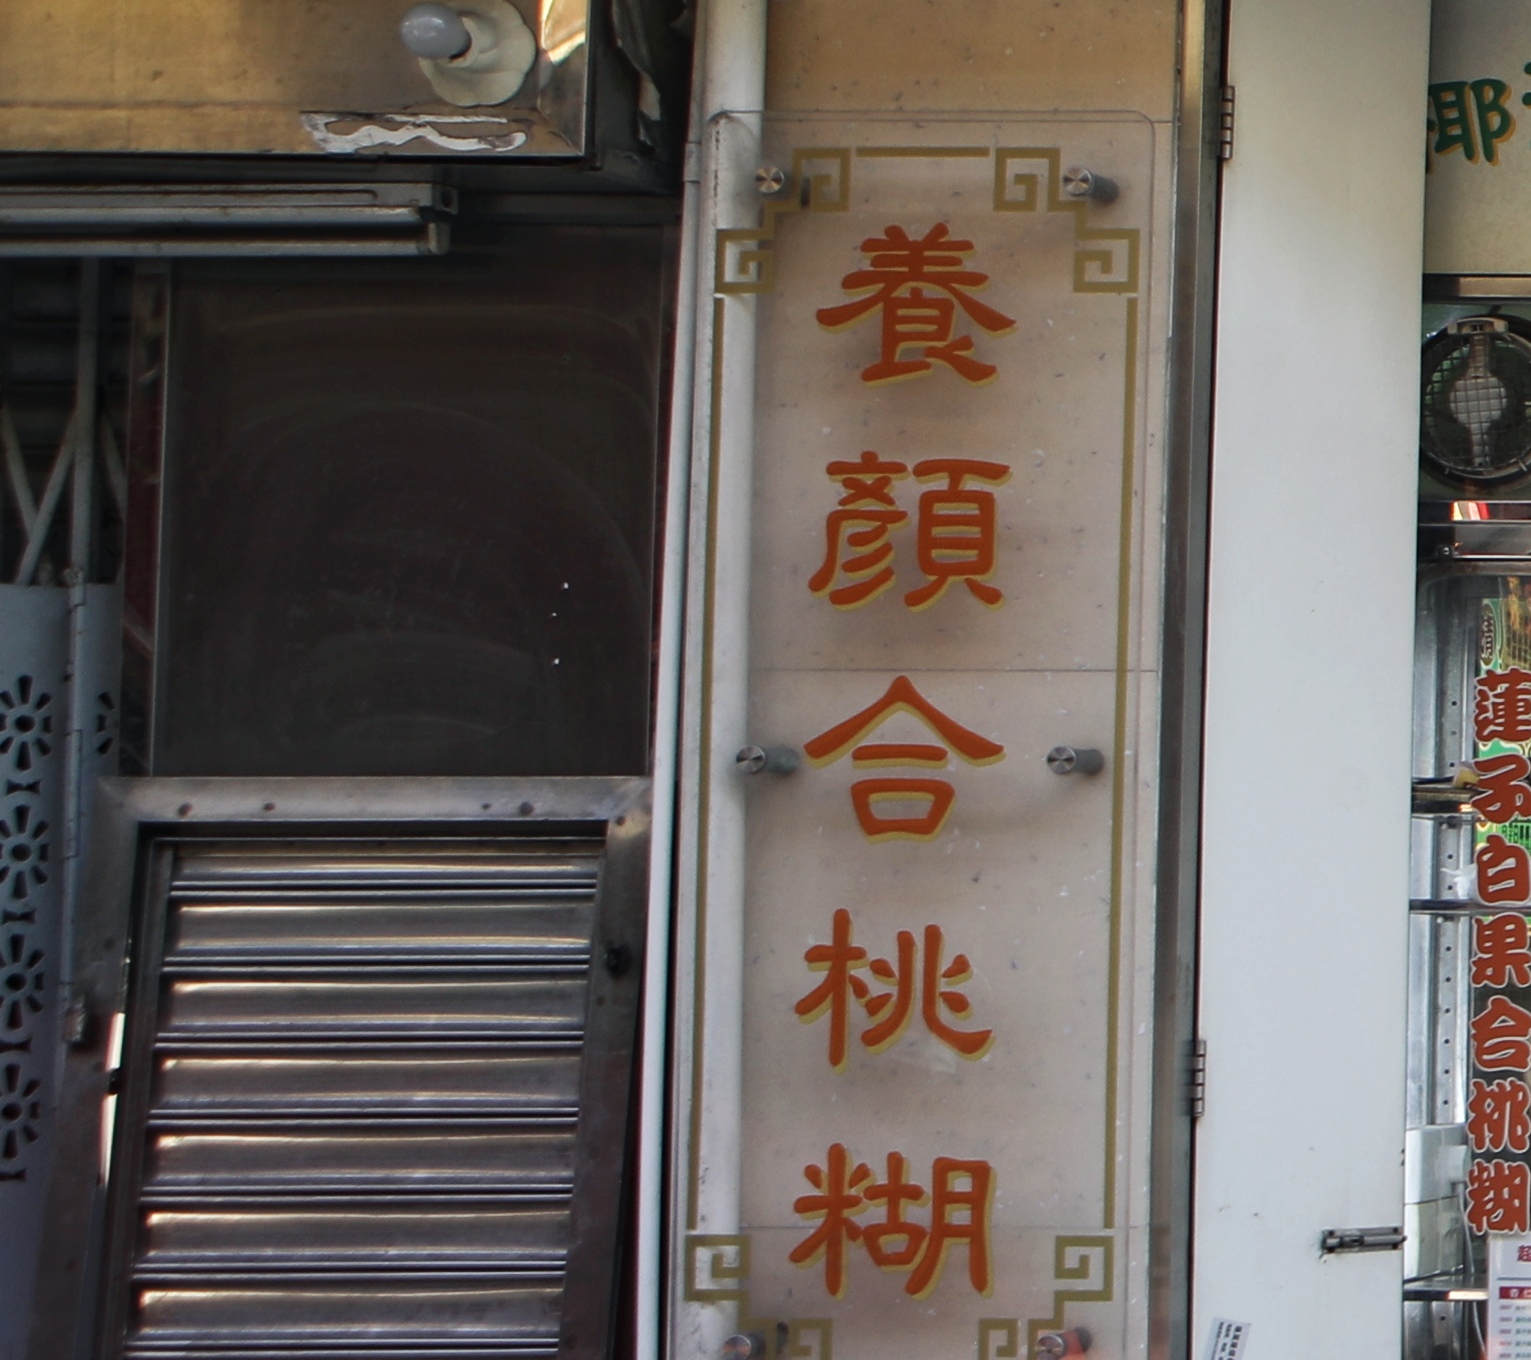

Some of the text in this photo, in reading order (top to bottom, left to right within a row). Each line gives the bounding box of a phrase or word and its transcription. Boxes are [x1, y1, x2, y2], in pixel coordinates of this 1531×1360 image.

[788, 222, 1017, 1300] 養顏合桃糊
